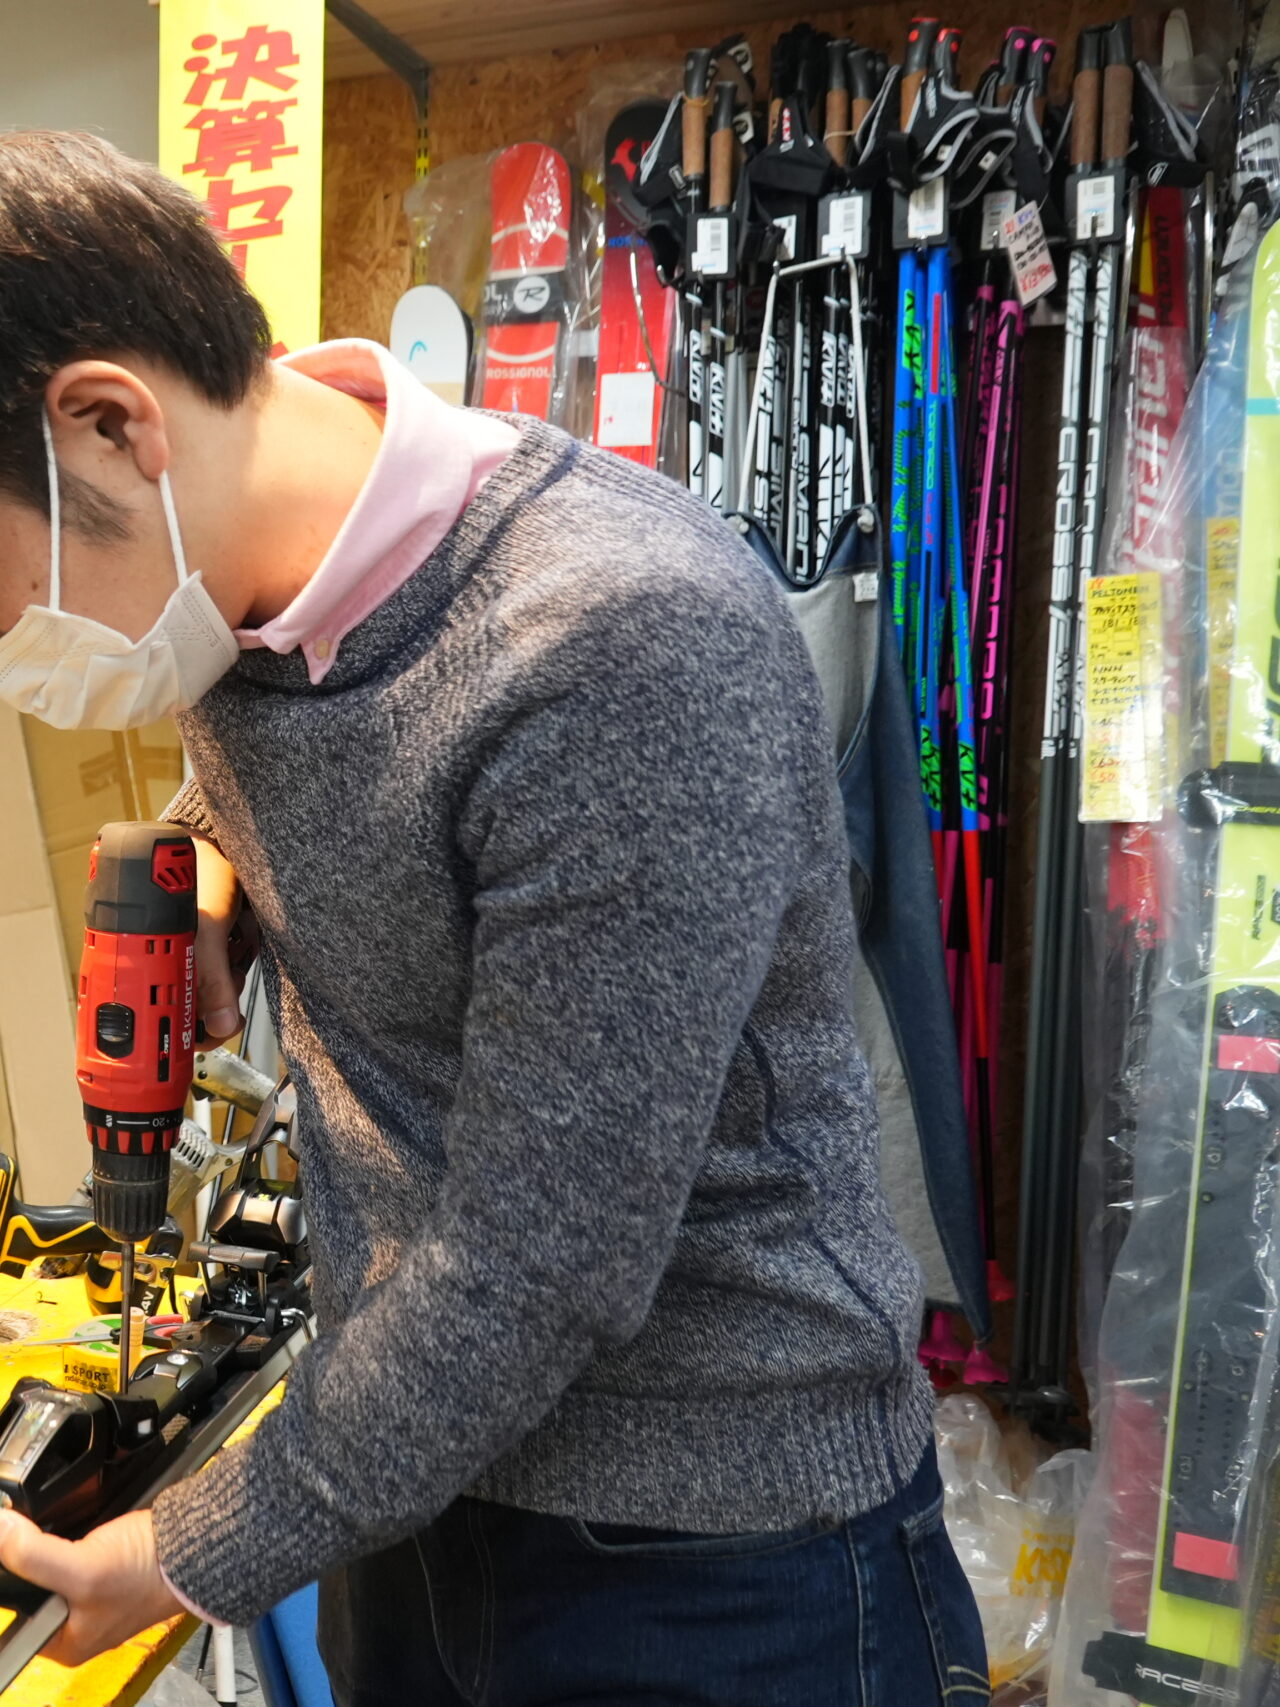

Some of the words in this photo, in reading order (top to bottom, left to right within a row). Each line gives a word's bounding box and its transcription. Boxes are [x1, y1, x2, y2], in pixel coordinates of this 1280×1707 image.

[486, 366, 552, 380] ROSSIGNOL
[184, 945, 195, 1029] KYOCERA
[72, 1365, 110, 1383] SPORT
